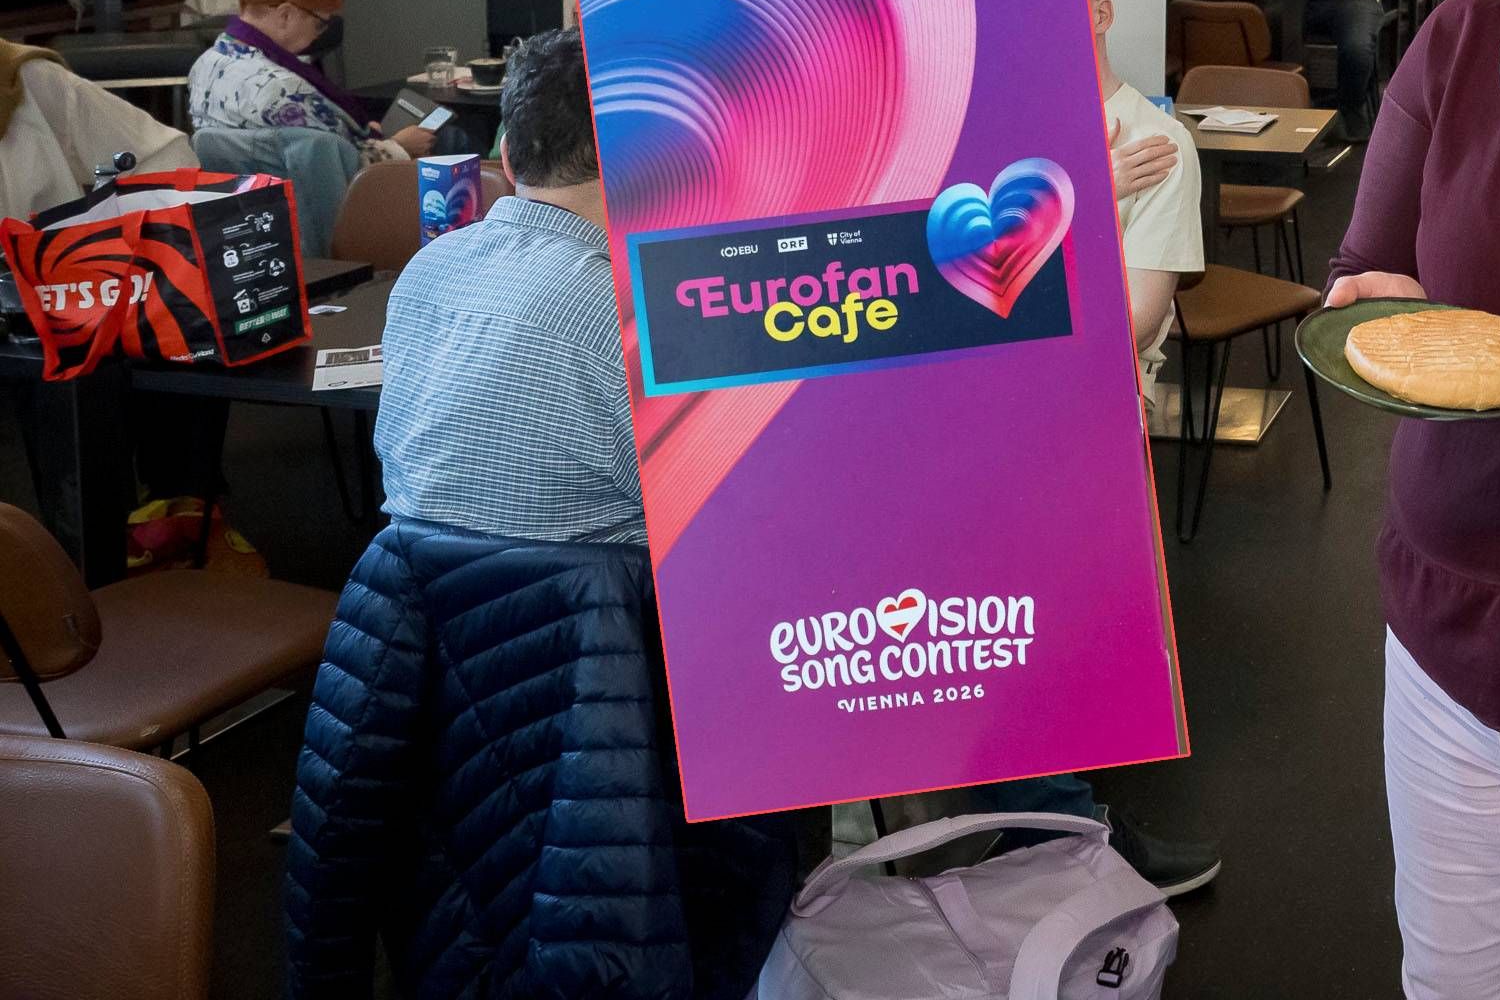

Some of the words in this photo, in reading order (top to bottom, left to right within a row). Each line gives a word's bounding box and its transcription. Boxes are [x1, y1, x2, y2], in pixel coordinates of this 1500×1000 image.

[780, 239, 806, 250] ORF
[839, 230, 852, 241] City
[840, 237, 863, 245] Vienna
[738, 244, 759, 256] EBU
[675, 261, 920, 318] Eurofan
[764, 291, 898, 343] Cafe
[780, 649, 877, 693] SONG
[879, 637, 1034, 681] CONTEST
[837, 690, 924, 713] VIENNA
[933, 683, 985, 703] 2026
